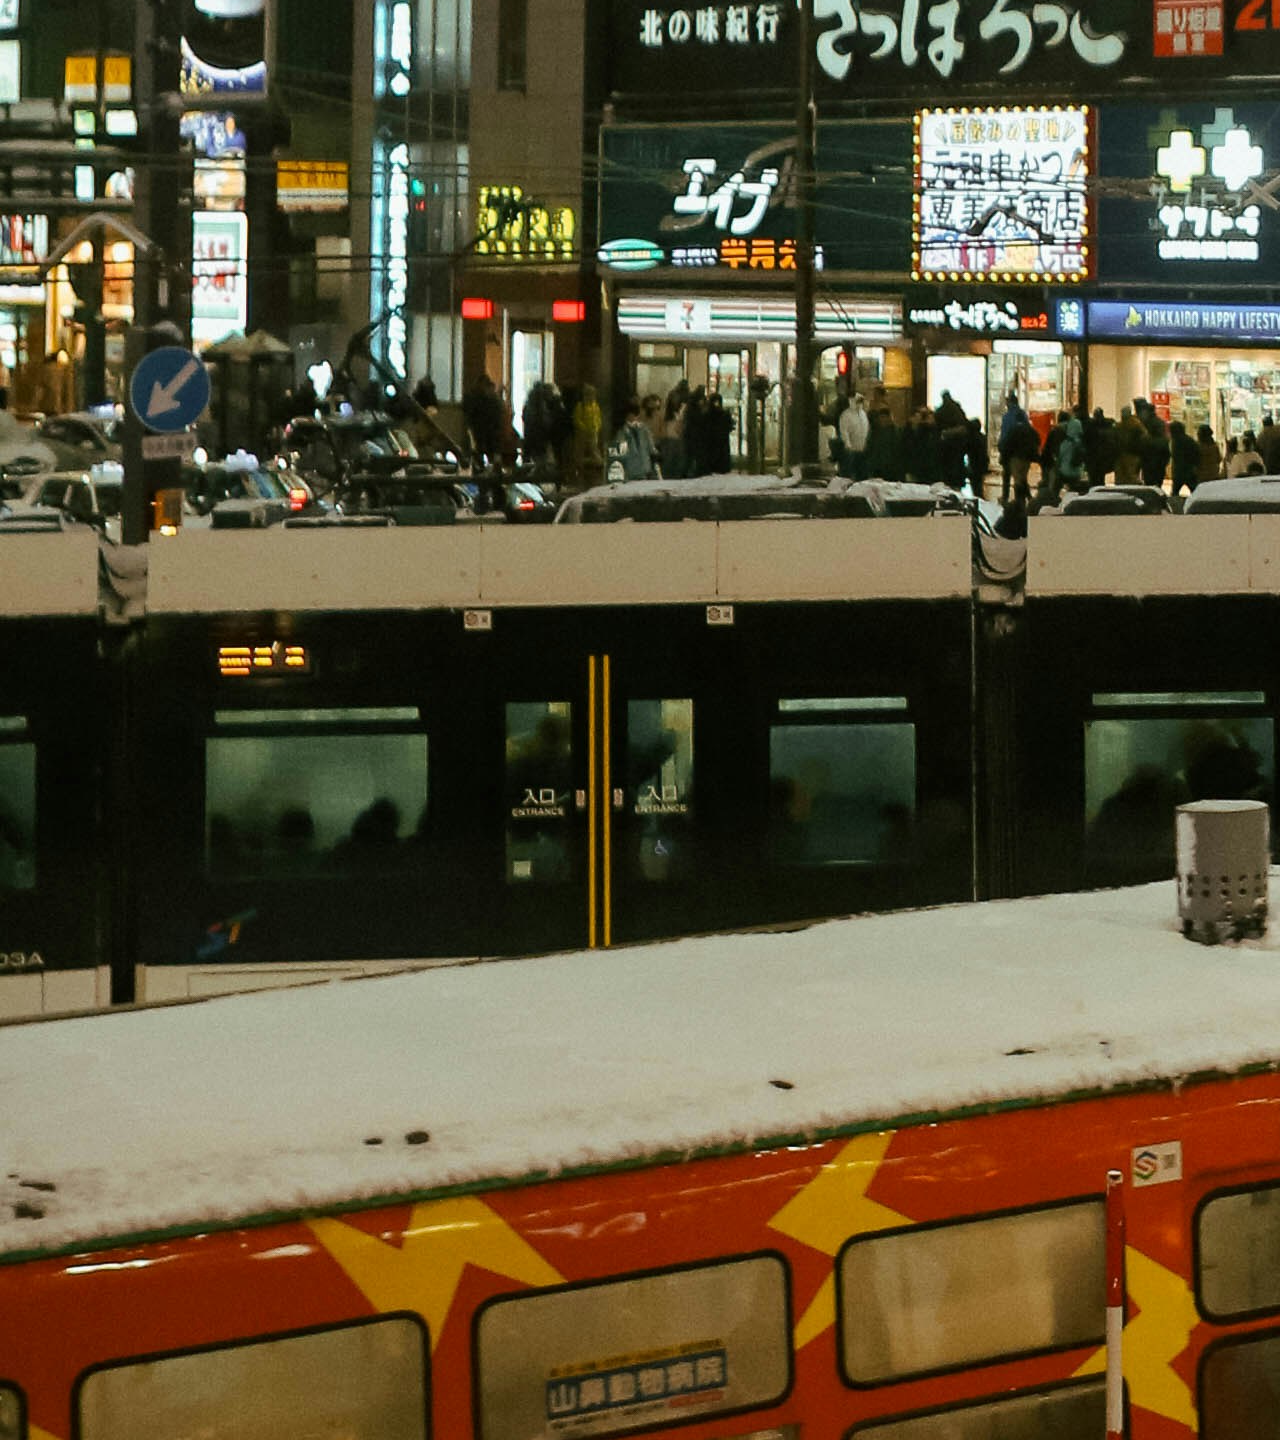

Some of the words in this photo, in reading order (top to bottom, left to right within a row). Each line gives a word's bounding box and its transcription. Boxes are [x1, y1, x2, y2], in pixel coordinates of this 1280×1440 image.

[639, 3, 781, 46] 北の味紀行
[1144, 308, 1199, 328] HOKKAIDO
[1202, 309, 1237, 330] HAPPY
[523, 788, 555, 804] 入口
[648, 785, 678, 802] 入口
[512, 807, 564, 818] ENTRANCE
